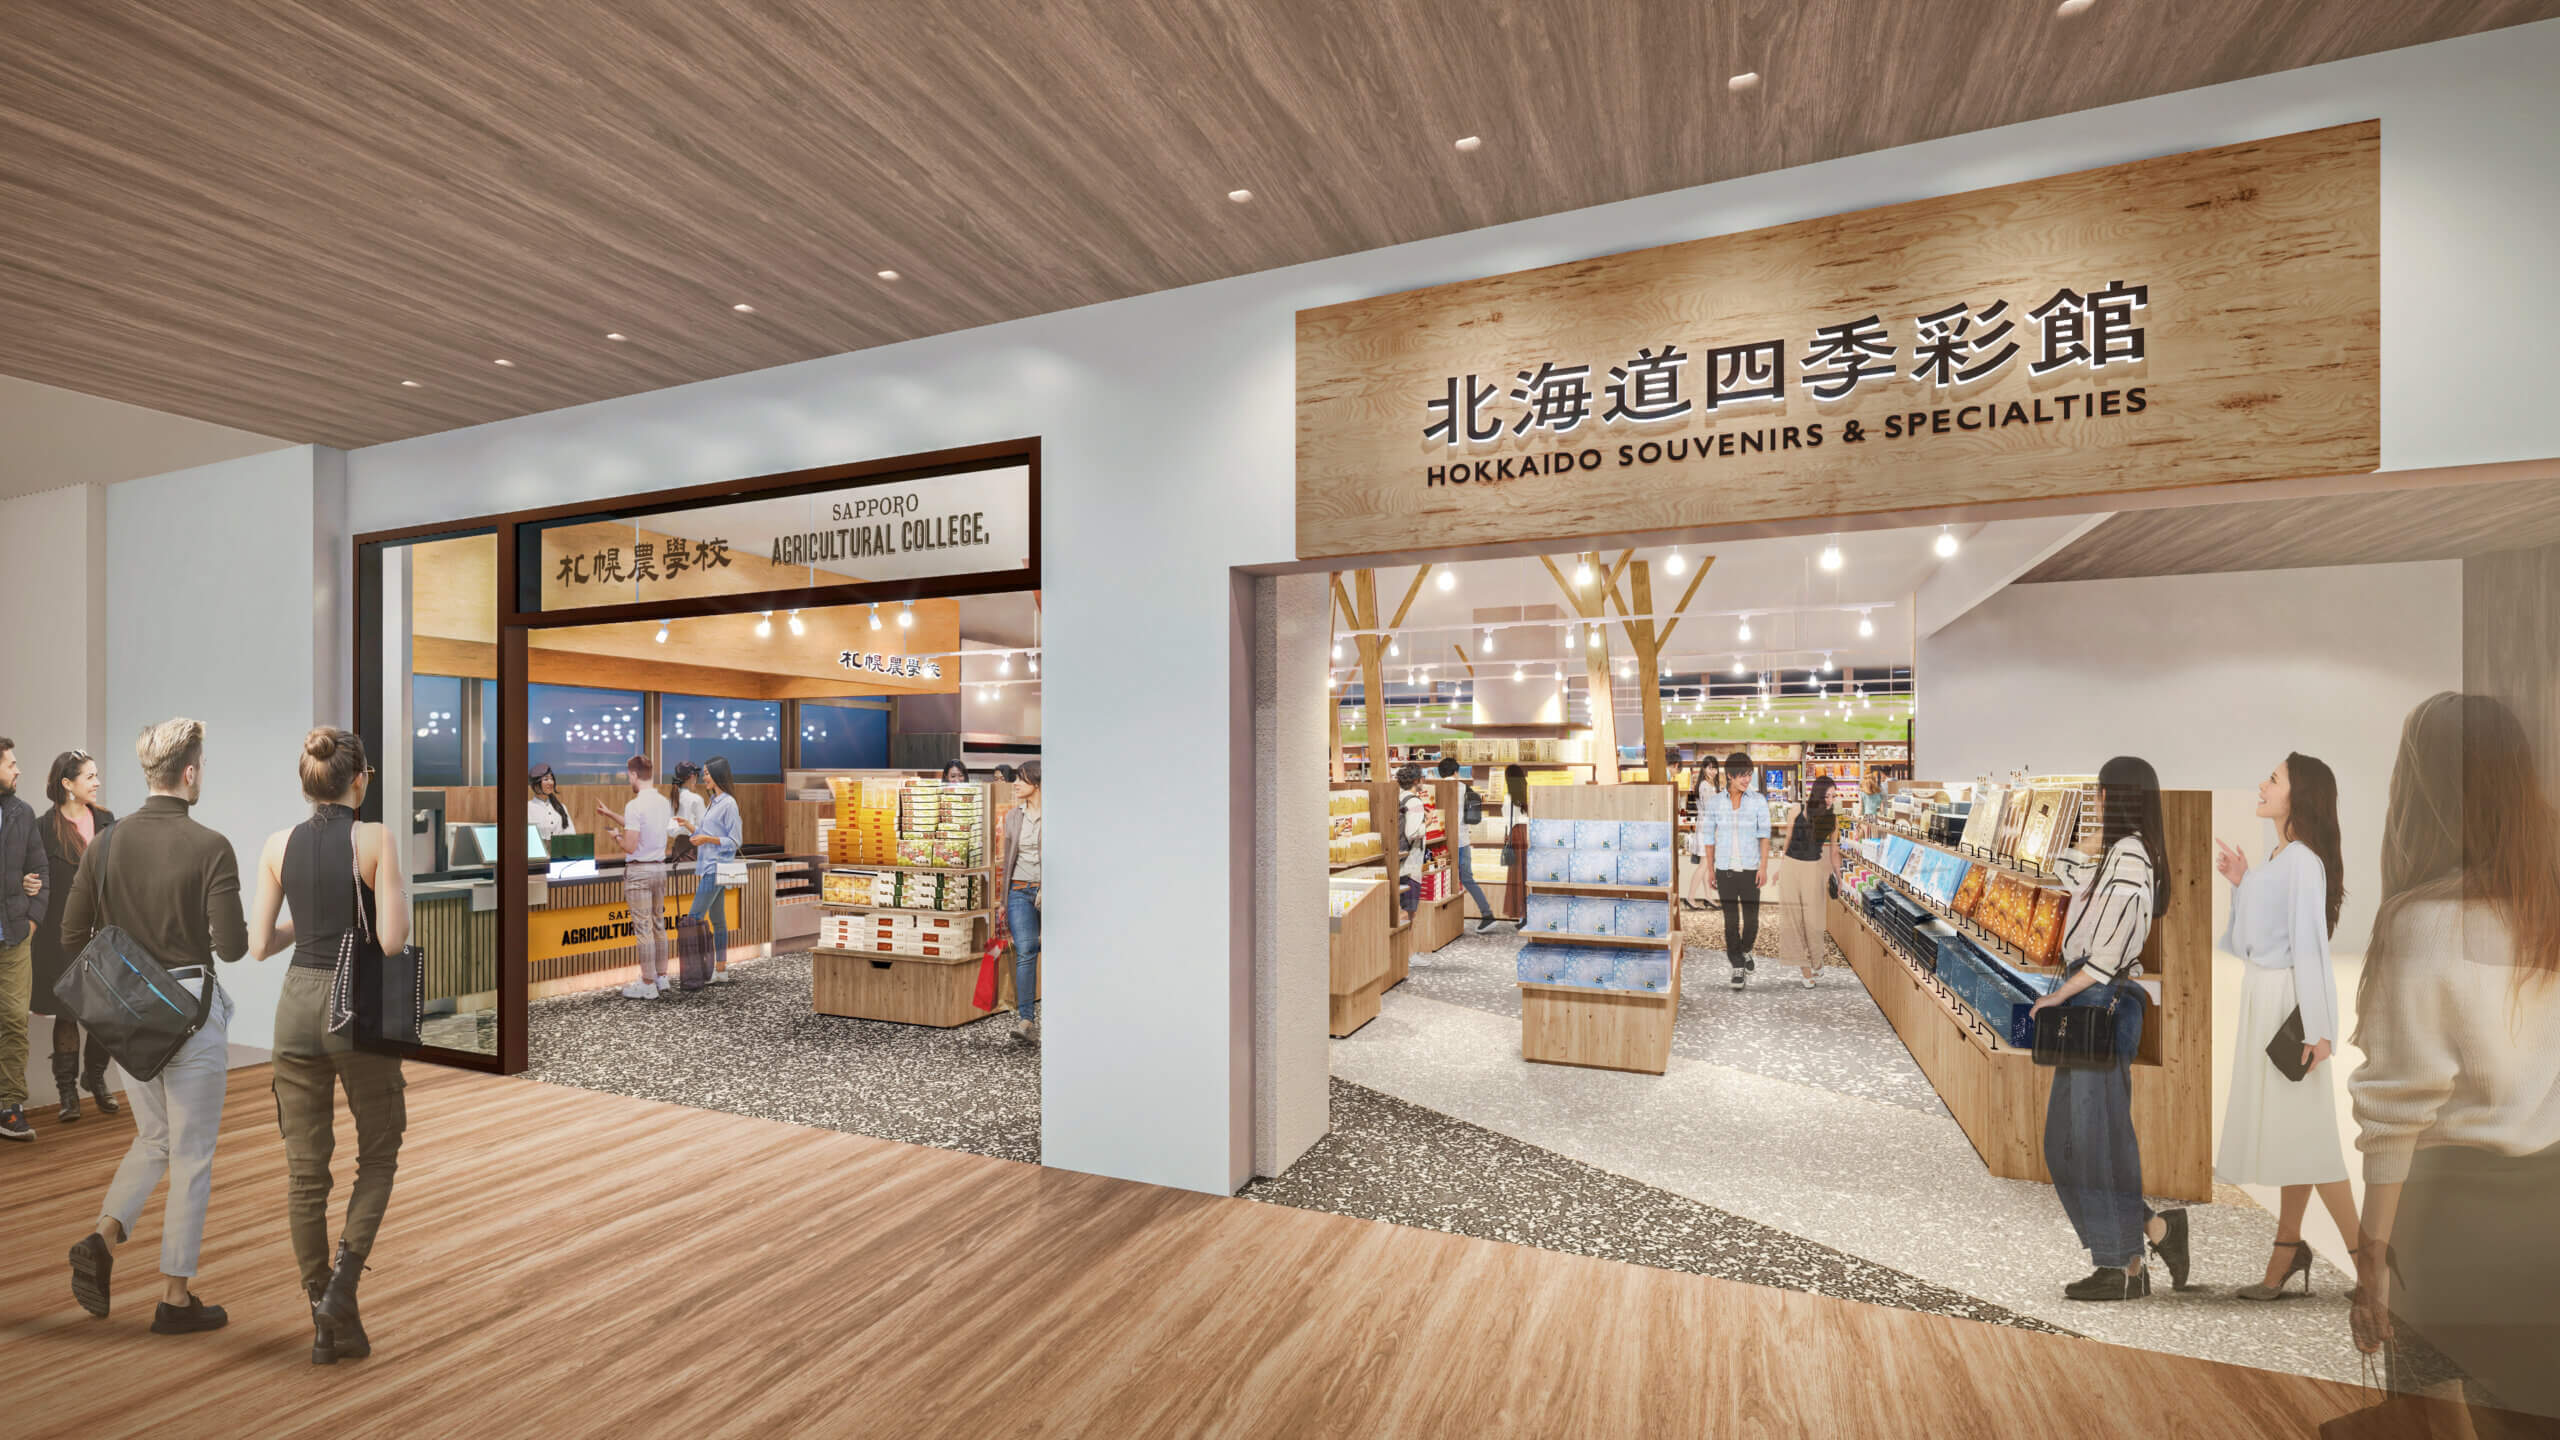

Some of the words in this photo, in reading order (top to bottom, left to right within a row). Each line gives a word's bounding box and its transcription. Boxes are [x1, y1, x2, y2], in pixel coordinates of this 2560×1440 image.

[1424, 280, 2148, 444] 北海道四季彩館
[1427, 448, 1602, 487] HOKKAIDO
[1618, 423, 1823, 466] SOUVENIRS
[1842, 419, 1866, 443] &
[1884, 387, 2148, 440] SPECIALTIES
[831, 493, 919, 521] SAPPORO
[556, 537, 732, 588] 札幌農學校
[771, 523, 896, 567] AGRICULTURAL
[561, 921, 636, 946] AGRICULTUR
